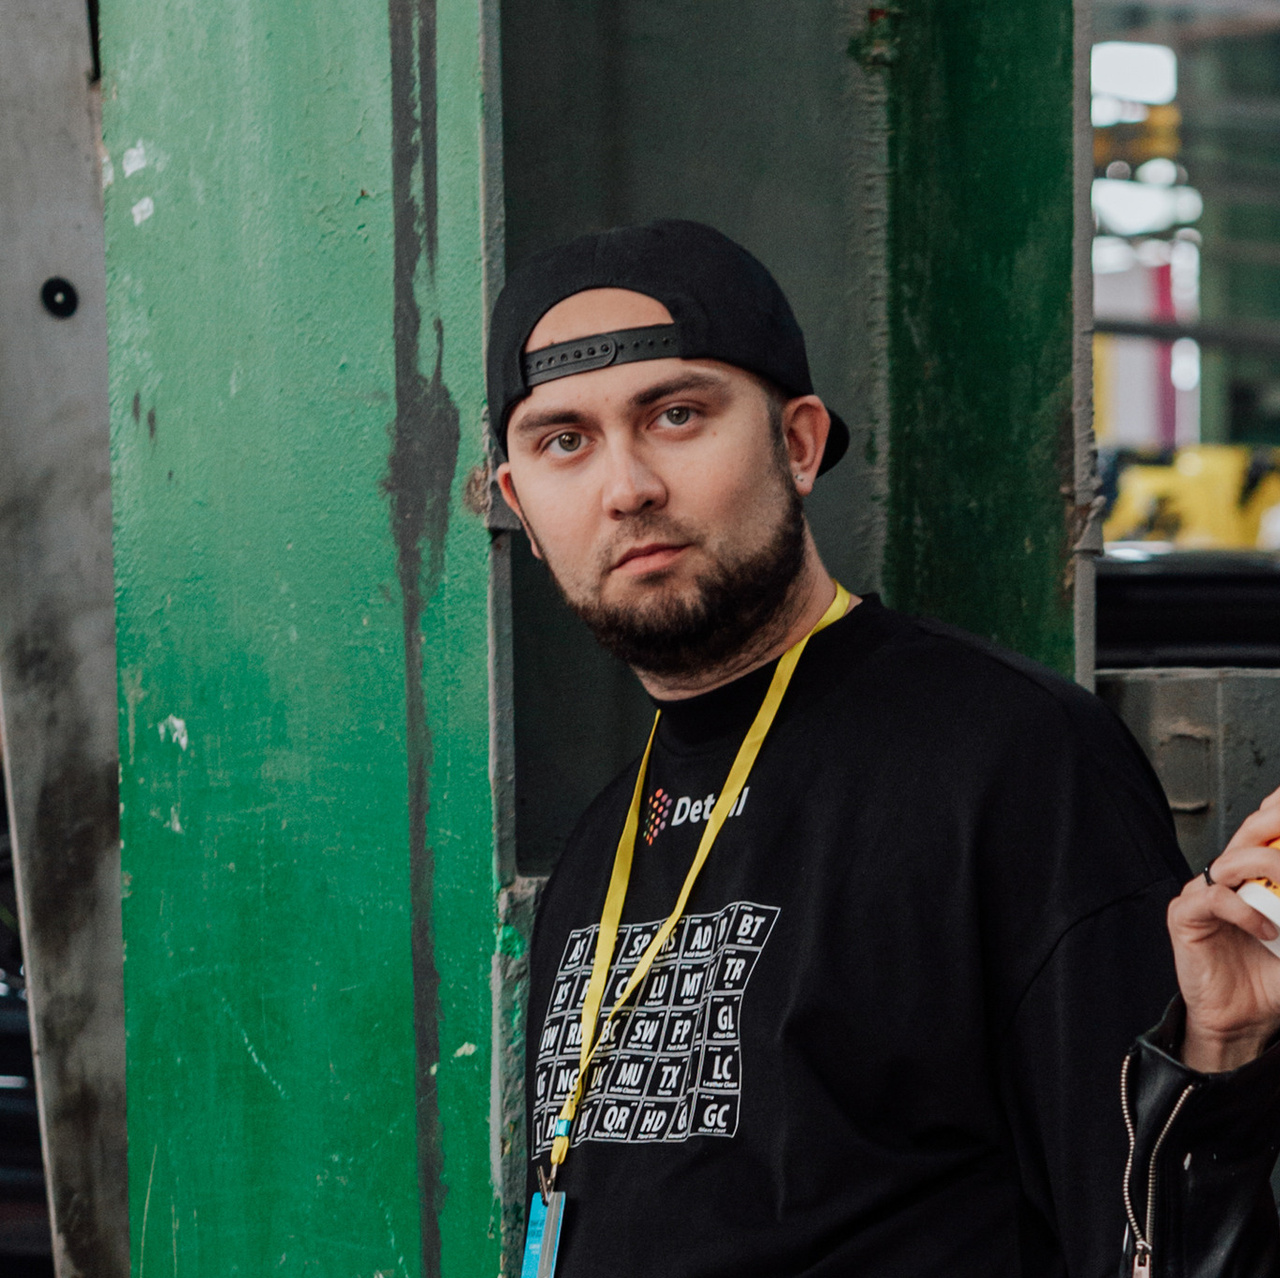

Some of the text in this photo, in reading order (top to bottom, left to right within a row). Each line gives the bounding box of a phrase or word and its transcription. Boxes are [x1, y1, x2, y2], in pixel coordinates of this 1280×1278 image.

[671, 787, 750, 826] Detil
[690, 925, 713, 950] AD
[737, 914, 766, 938] BT
[629, 934, 652, 956] SP
[723, 958, 746, 981] TR
[649, 974, 669, 999] LU
[680, 971, 704, 997] MT
[717, 1005, 735, 1030] GL
[630, 1019, 660, 1043] SW
[670, 1019, 692, 1043] FP
[616, 1062, 645, 1087] MU
[659, 1065, 682, 1089] TX
[712, 1055, 734, 1080] LC
[603, 1106, 631, 1132] QR
[640, 1110, 667, 1133] HD
[703, 1103, 731, 1128] GC
